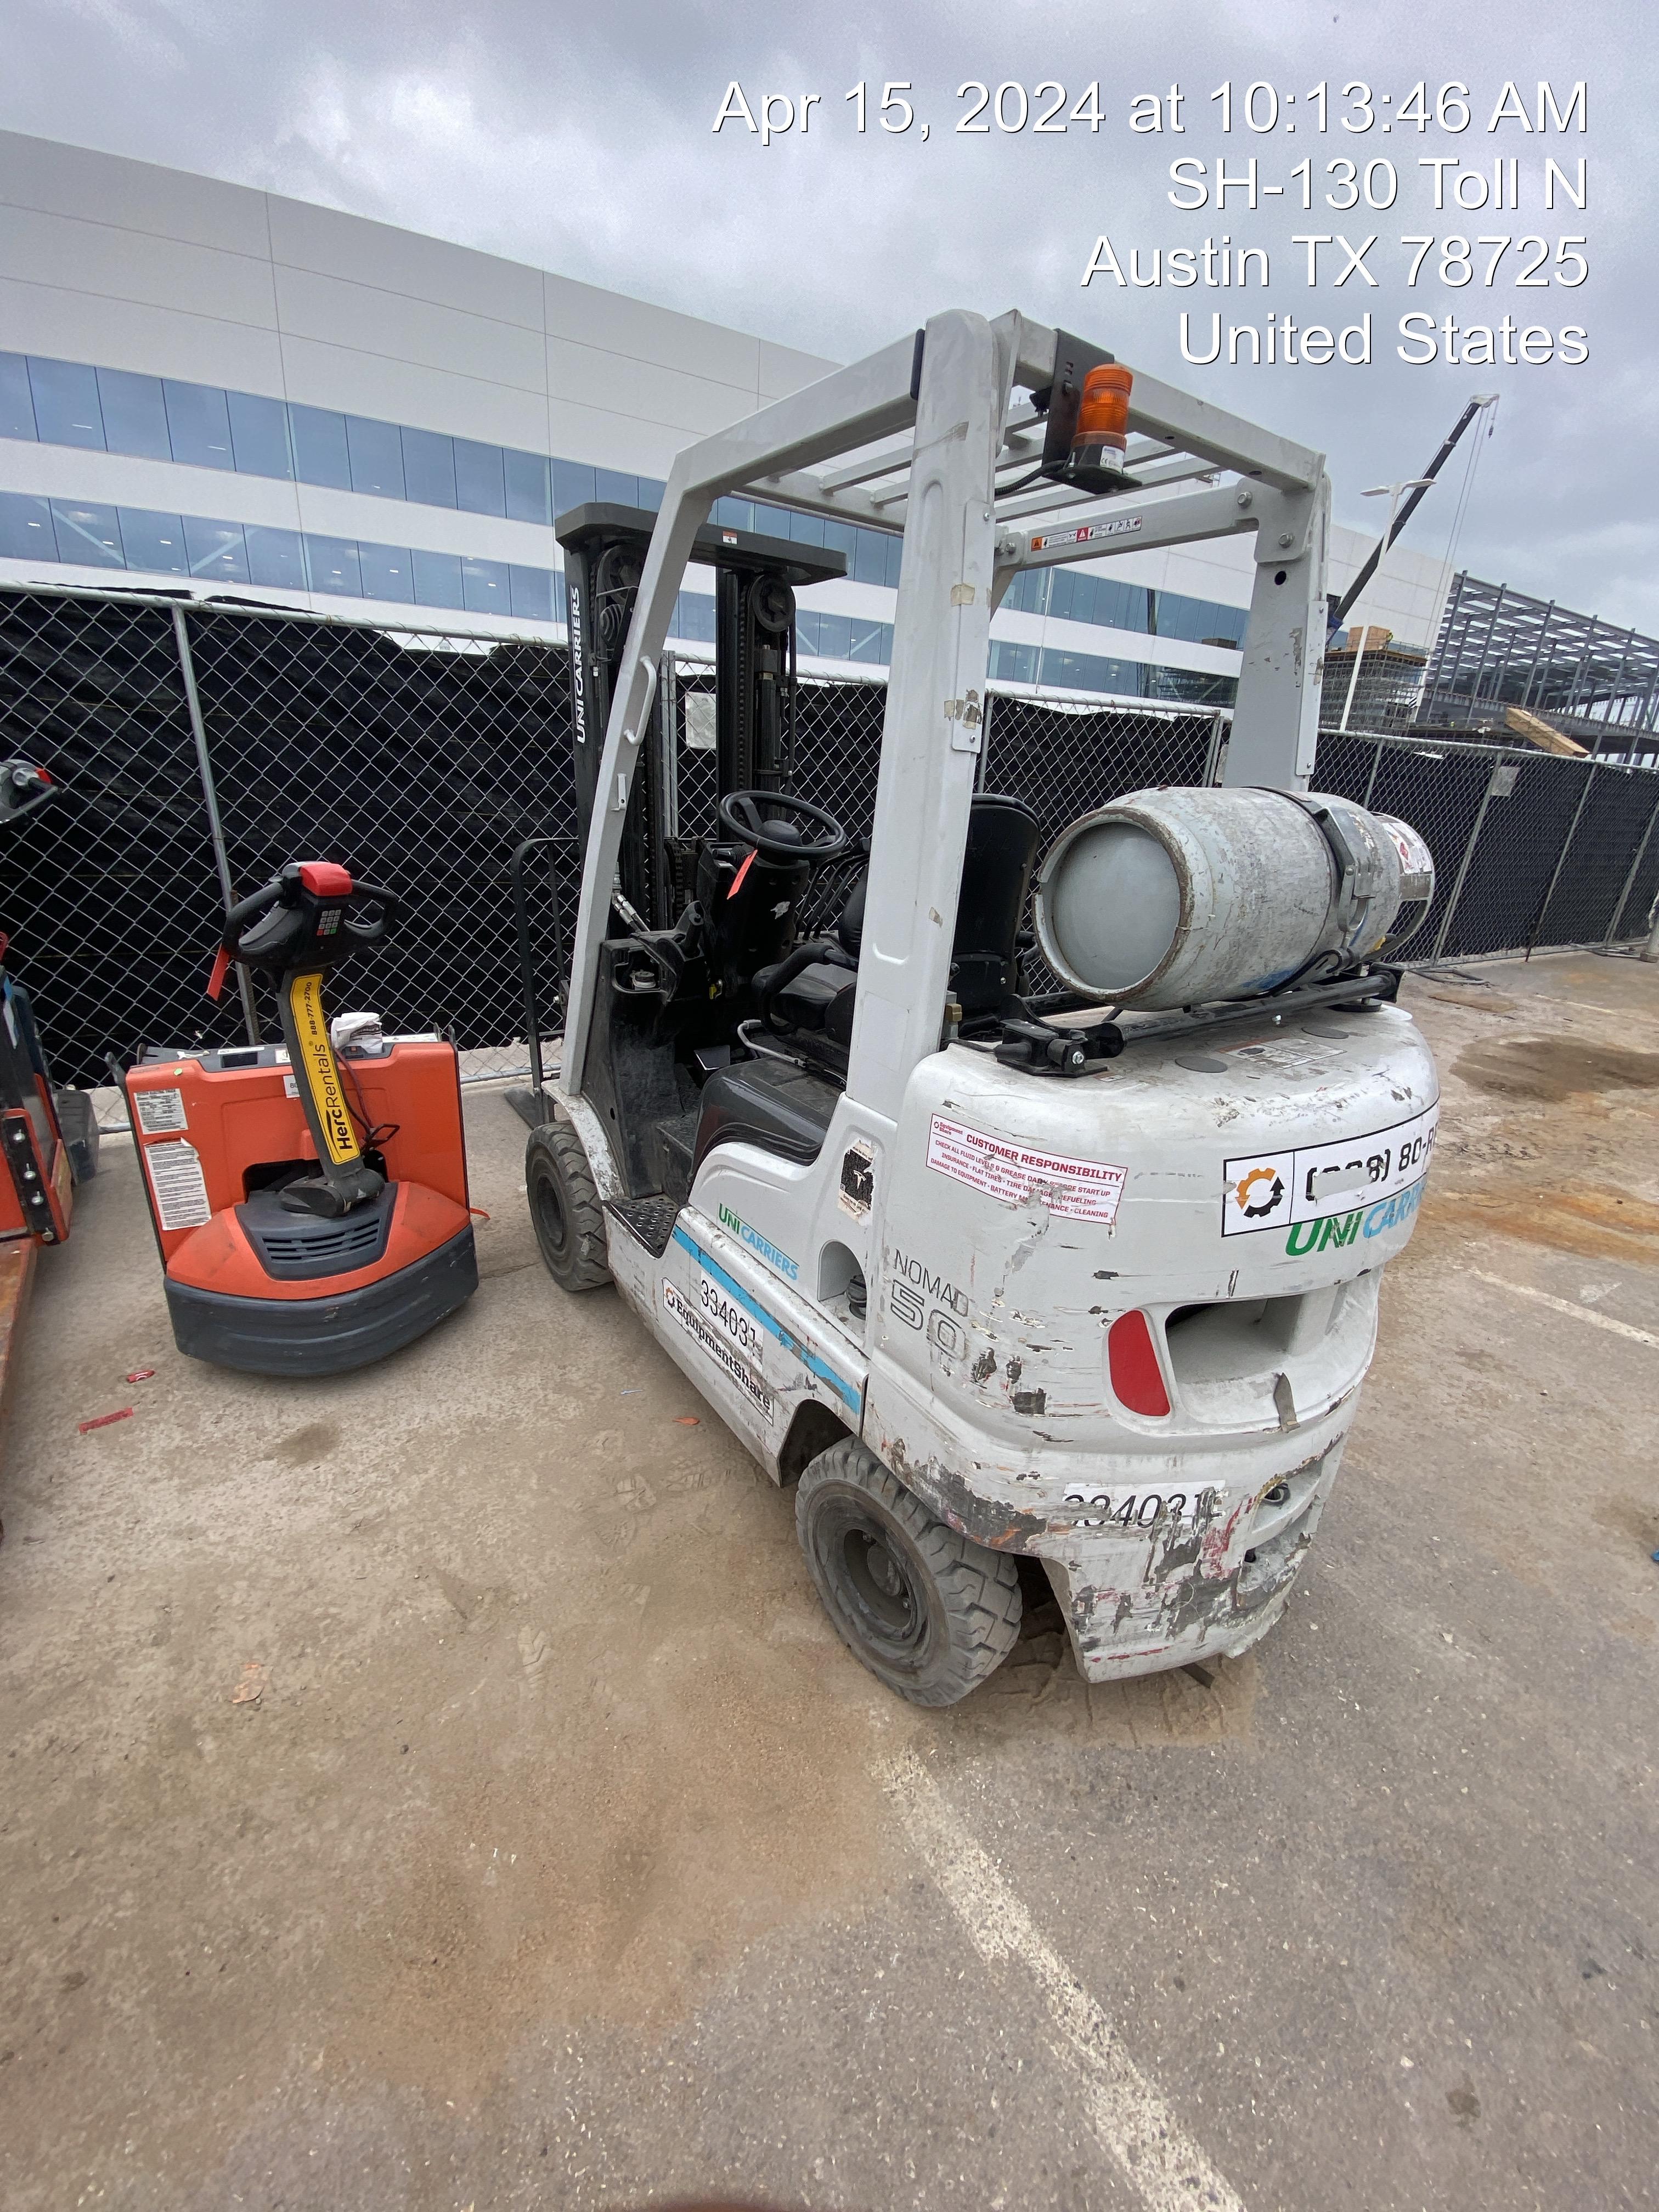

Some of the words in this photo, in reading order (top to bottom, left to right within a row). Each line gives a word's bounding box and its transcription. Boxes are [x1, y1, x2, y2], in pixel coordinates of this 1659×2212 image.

[303, 981, 318, 1036] 888-777-2700
[940, 1122, 963, 1135] Equipment
[935, 1139, 951, 1151] CHECK
[961, 1150, 975, 1161] FLUID
[975, 1157, 994, 1169] LEVELS
[1001, 1167, 1026, 1180] GREASE
[1078, 1187, 1100, 1196] START
[941, 1153, 969, 1169] INSURANCE
[972, 1166, 983, 1176] FLAT
[985, 1171, 1002, 1183] TIRES
[1006, 1180, 1022, 1189] TIRE
[1060, 1194, 1097, 1206] EFUELING
[967, 1134, 1019, 1161] CUSTOMER
[1021, 1154, 1122, 1182] RESPONSIBILITY
[931, 1158, 950, 1171] DAMAGE
[958, 1170, 987, 1187] EQUIPMENT
[990, 1185, 1018, 1198] BATTERY
[1074, 1207, 1109, 1218] CLEANING
[894, 1248, 969, 1317] NOMAD
[701, 1279, 757, 1357] 334031
[890, 1279, 967, 1361] 50
[676, 1297, 771, 1411] EquipmentShare
